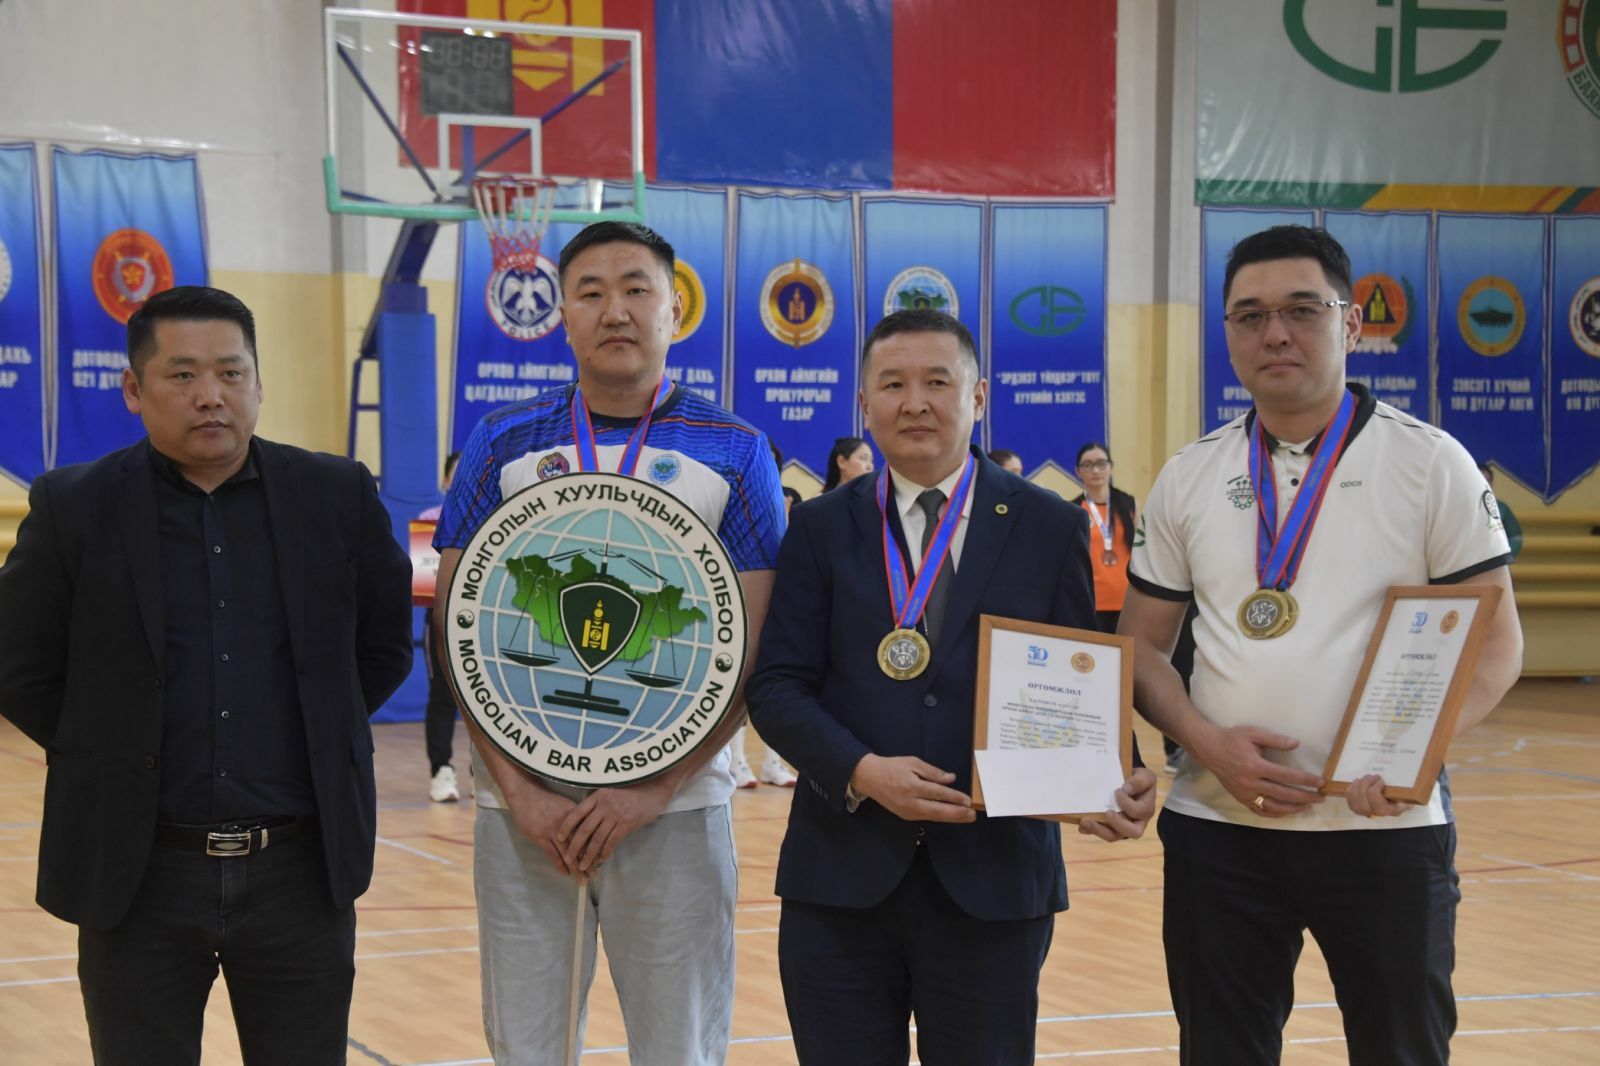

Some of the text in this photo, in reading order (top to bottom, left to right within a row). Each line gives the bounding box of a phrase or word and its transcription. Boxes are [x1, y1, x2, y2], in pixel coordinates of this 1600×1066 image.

[478, 361, 574, 380] ОРХОН АЙМГИЙН
[755, 366, 838, 383] ОРХОН АЙМГИЙН
[765, 388, 831, 403] ПРОКУРОРЫН
[782, 407, 814, 421] ГАЗАР
[461, 484, 734, 644] МОНГОЛЫН ХУУЛЬЧДЫН ХОЛБОО
[458, 639, 724, 773] MONGOLIAN BAR ASSOCIATION
